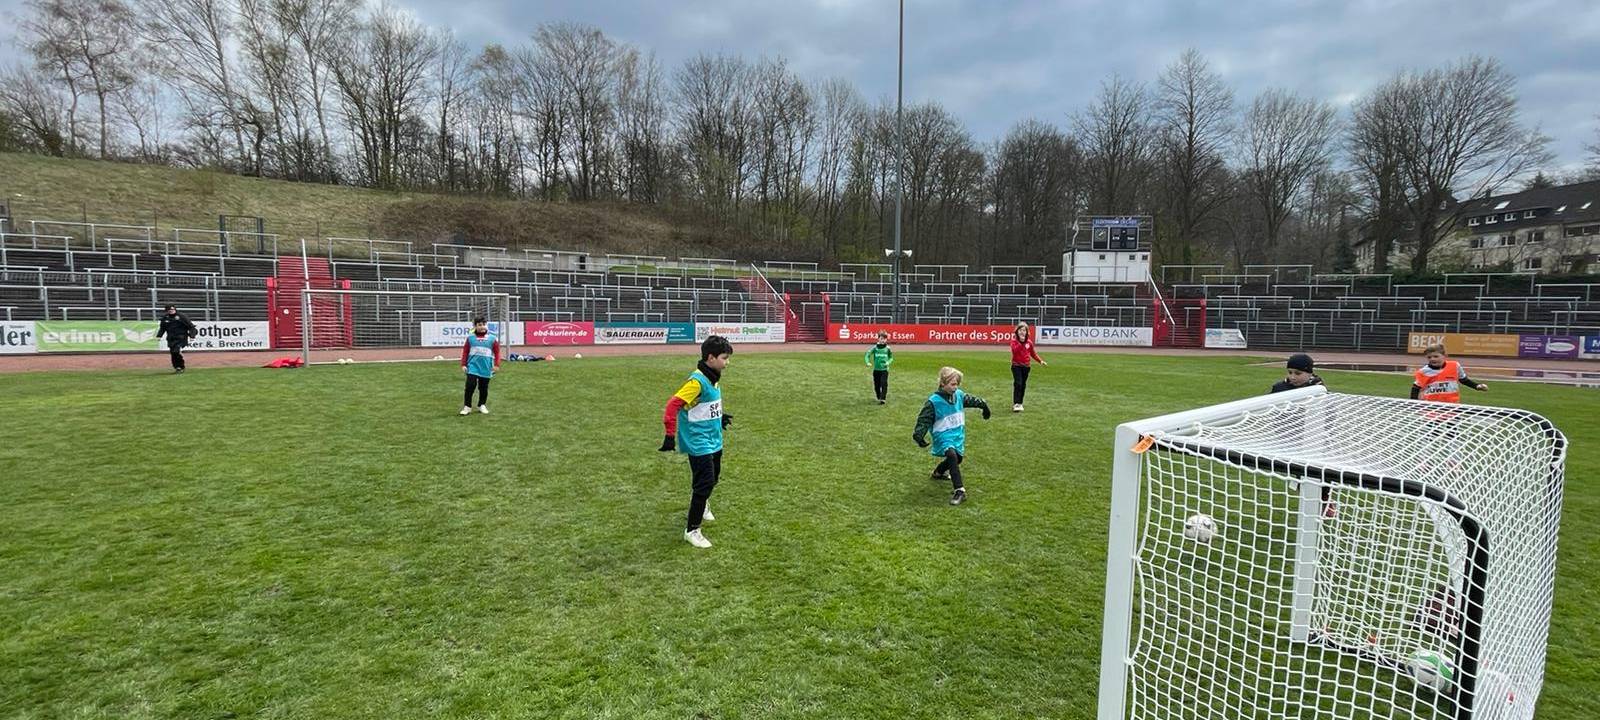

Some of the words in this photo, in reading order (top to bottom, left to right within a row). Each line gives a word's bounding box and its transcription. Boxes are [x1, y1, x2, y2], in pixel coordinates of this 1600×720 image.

[42, 329, 117, 343] erima
[199, 324, 246, 339] othaer
[853, 332, 891, 340] Sparkae
[929, 330, 967, 340] Partner
[972, 330, 988, 340] des
[990, 330, 1016, 342] Spor
[1062, 328, 1100, 338] GENO
[1103, 328, 1138, 338] BANK
[219, 340, 263, 348] Brencher
[1411, 335, 1445, 348] BECK
